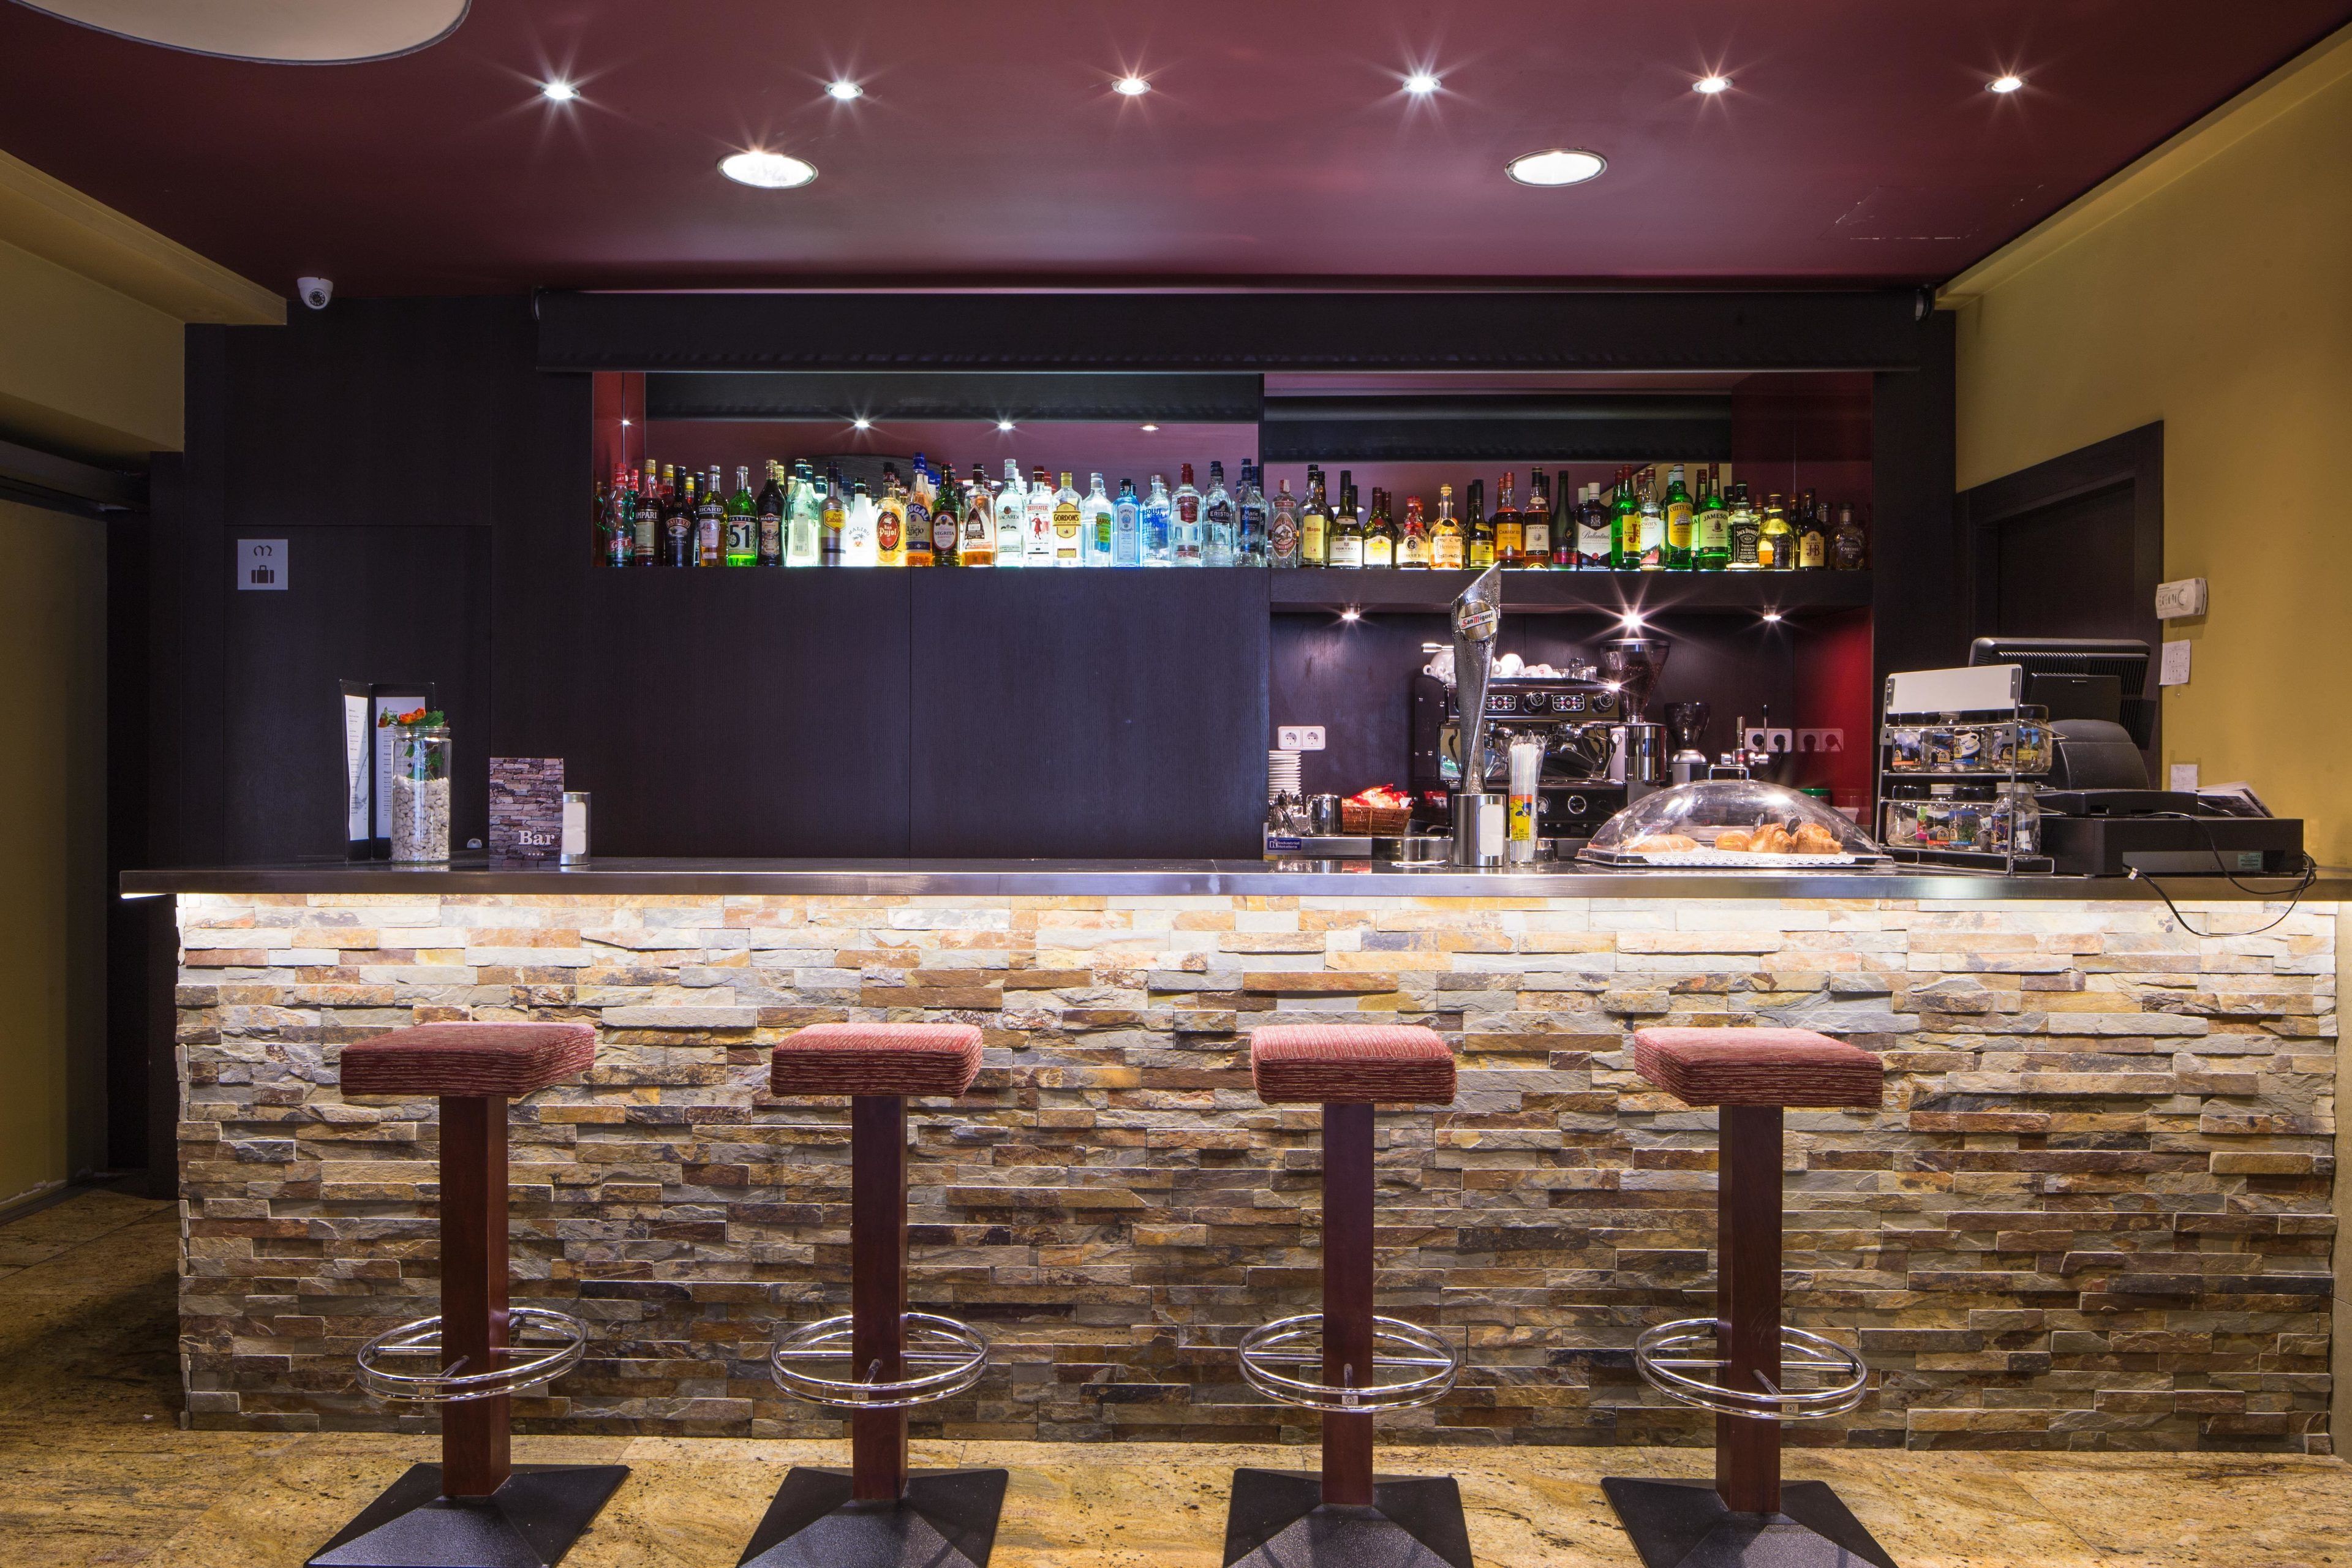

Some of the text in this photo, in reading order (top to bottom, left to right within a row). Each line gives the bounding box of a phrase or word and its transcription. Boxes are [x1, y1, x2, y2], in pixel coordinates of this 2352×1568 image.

[729, 524, 750, 548] 51
[849, 527, 870, 536] MALIBU
[879, 527, 897, 537] Pujol
[907, 526, 924, 536] Añejo
[1582, 530, 1610, 540] Ballantine's
[518, 830, 555, 845] Bar
